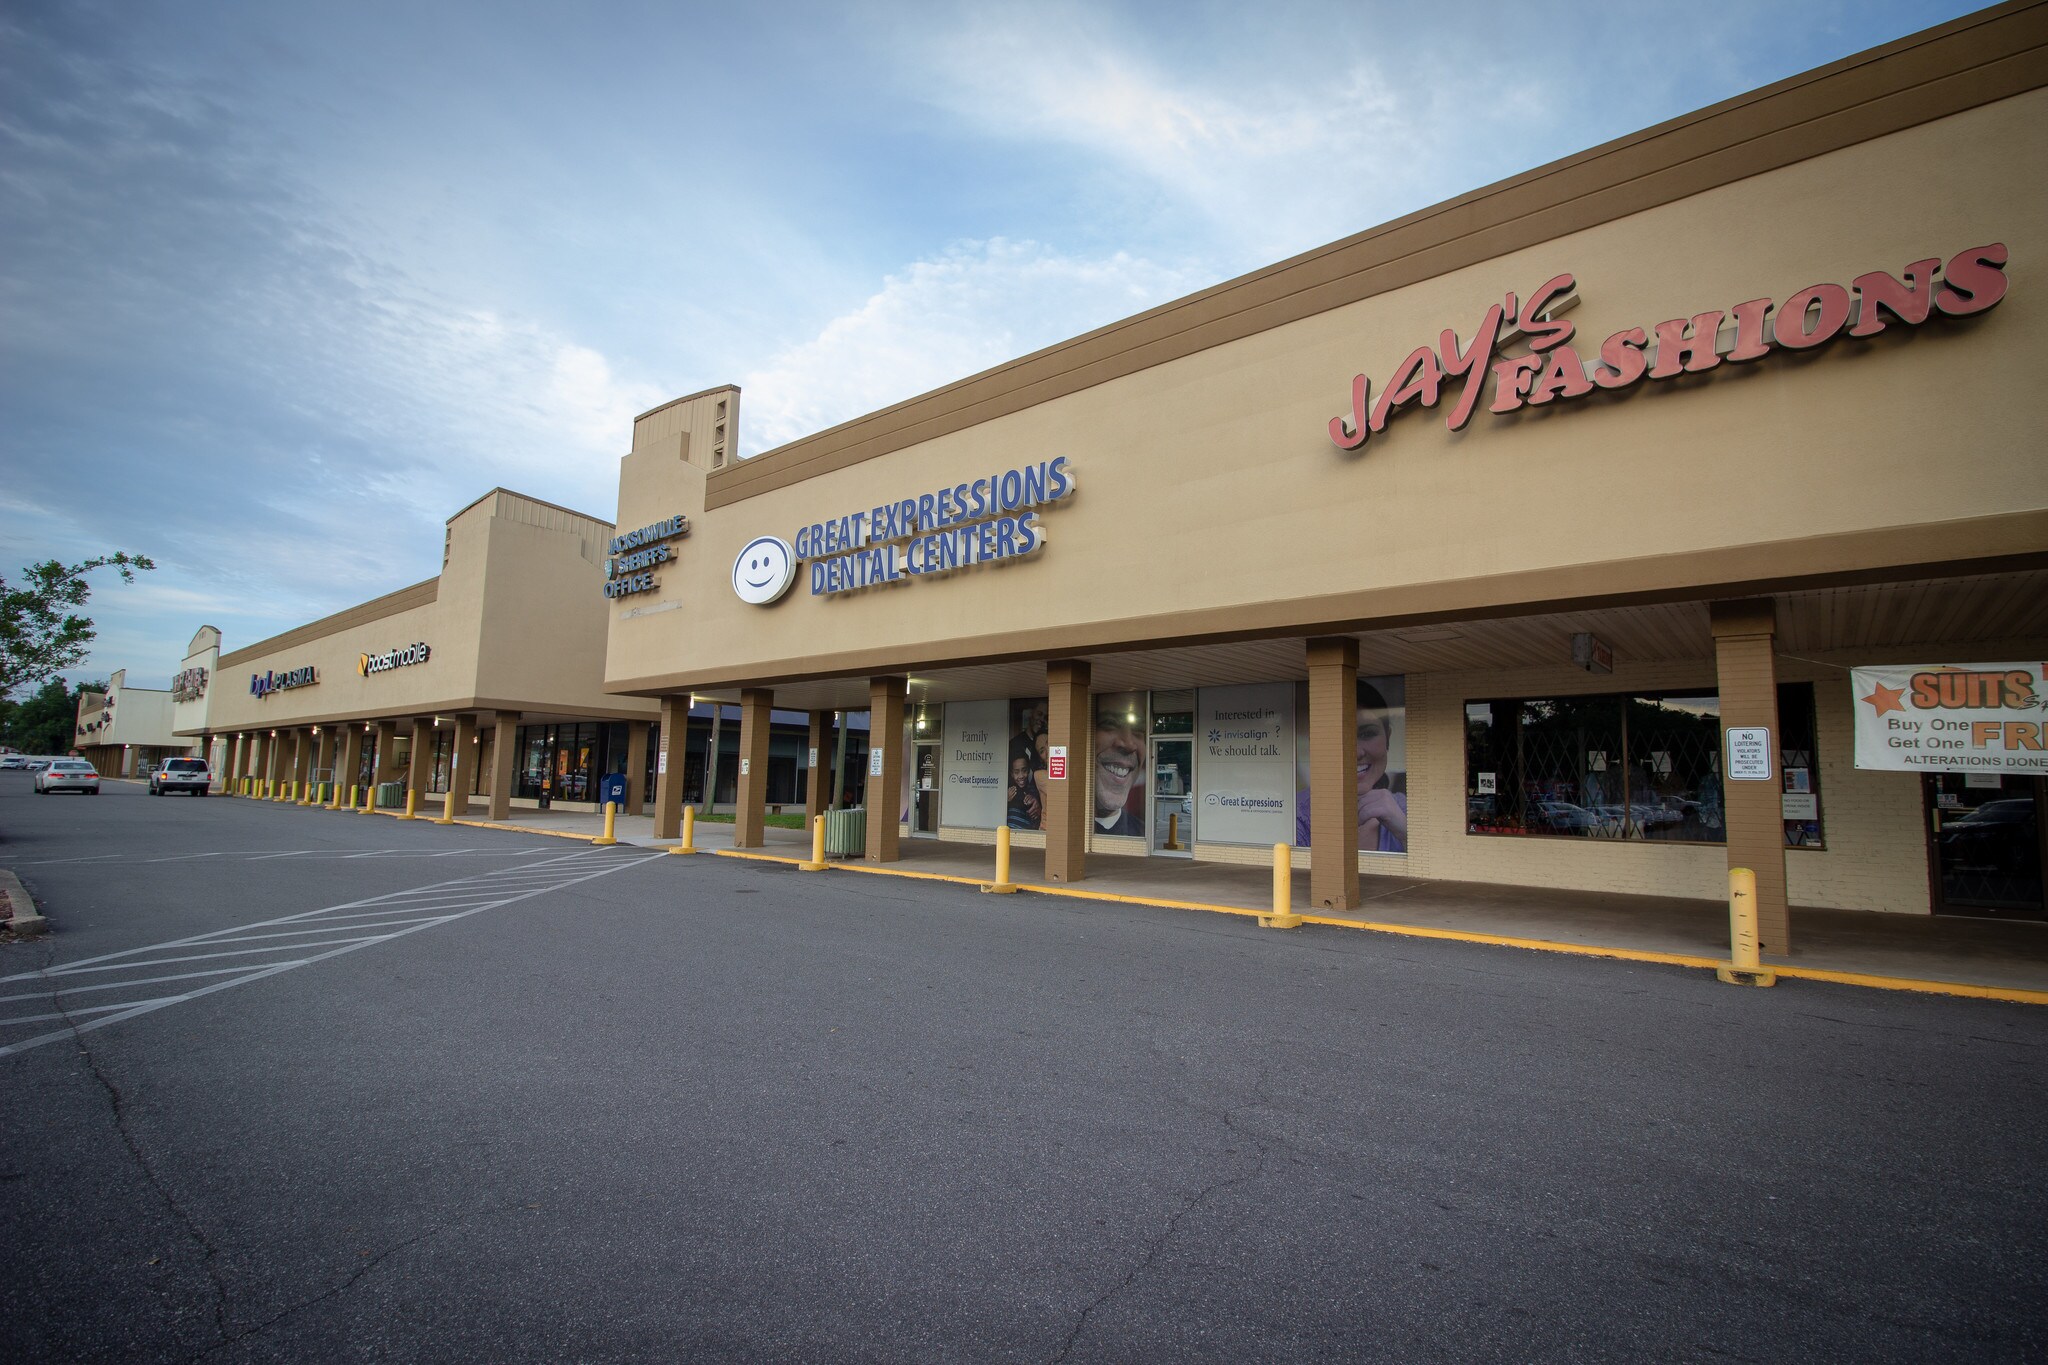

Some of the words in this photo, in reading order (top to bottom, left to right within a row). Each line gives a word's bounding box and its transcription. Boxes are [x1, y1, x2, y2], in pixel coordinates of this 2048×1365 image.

[1489, 242, 2009, 413] FASHIONS
[1328, 273, 1575, 450] JAY'S
[795, 512, 868, 560] GREAT
[871, 456, 1070, 542] EXPRESSIONS
[608, 515, 685, 555] JACKSONVILLE
[811, 545, 901, 596] DENTAL
[906, 511, 1040, 575] CENTERS
[603, 572, 653, 598] OFFICE
[275, 665, 315, 689] PLASMA
[1910, 670, 2035, 709] SUITS
[1215, 708, 1262, 720] Interested
[1265, 708, 1275, 719] in
[1224, 730, 1269, 741] invisalign
[1275, 725, 1281, 738] ?
[1888, 718, 1923, 733] Buy
[1930, 718, 1969, 731] One
[962, 730, 989, 745] Family
[1888, 737, 1920, 749] Get
[1926, 737, 1965, 749] One
[1972, 721, 2048, 751] FR
[956, 749, 994, 764] Dentistry
[1209, 745, 1222, 756] We
[1224, 745, 1257, 756] should
[1260, 745, 1281, 756] talk.
[1904, 755, 2001, 766] ALTERATIONS
[959, 775, 972, 784] Great
[972, 775, 999, 785] Expressions
[1220, 796, 1240, 807] Great
[1240, 797, 1283, 809] Expressions
